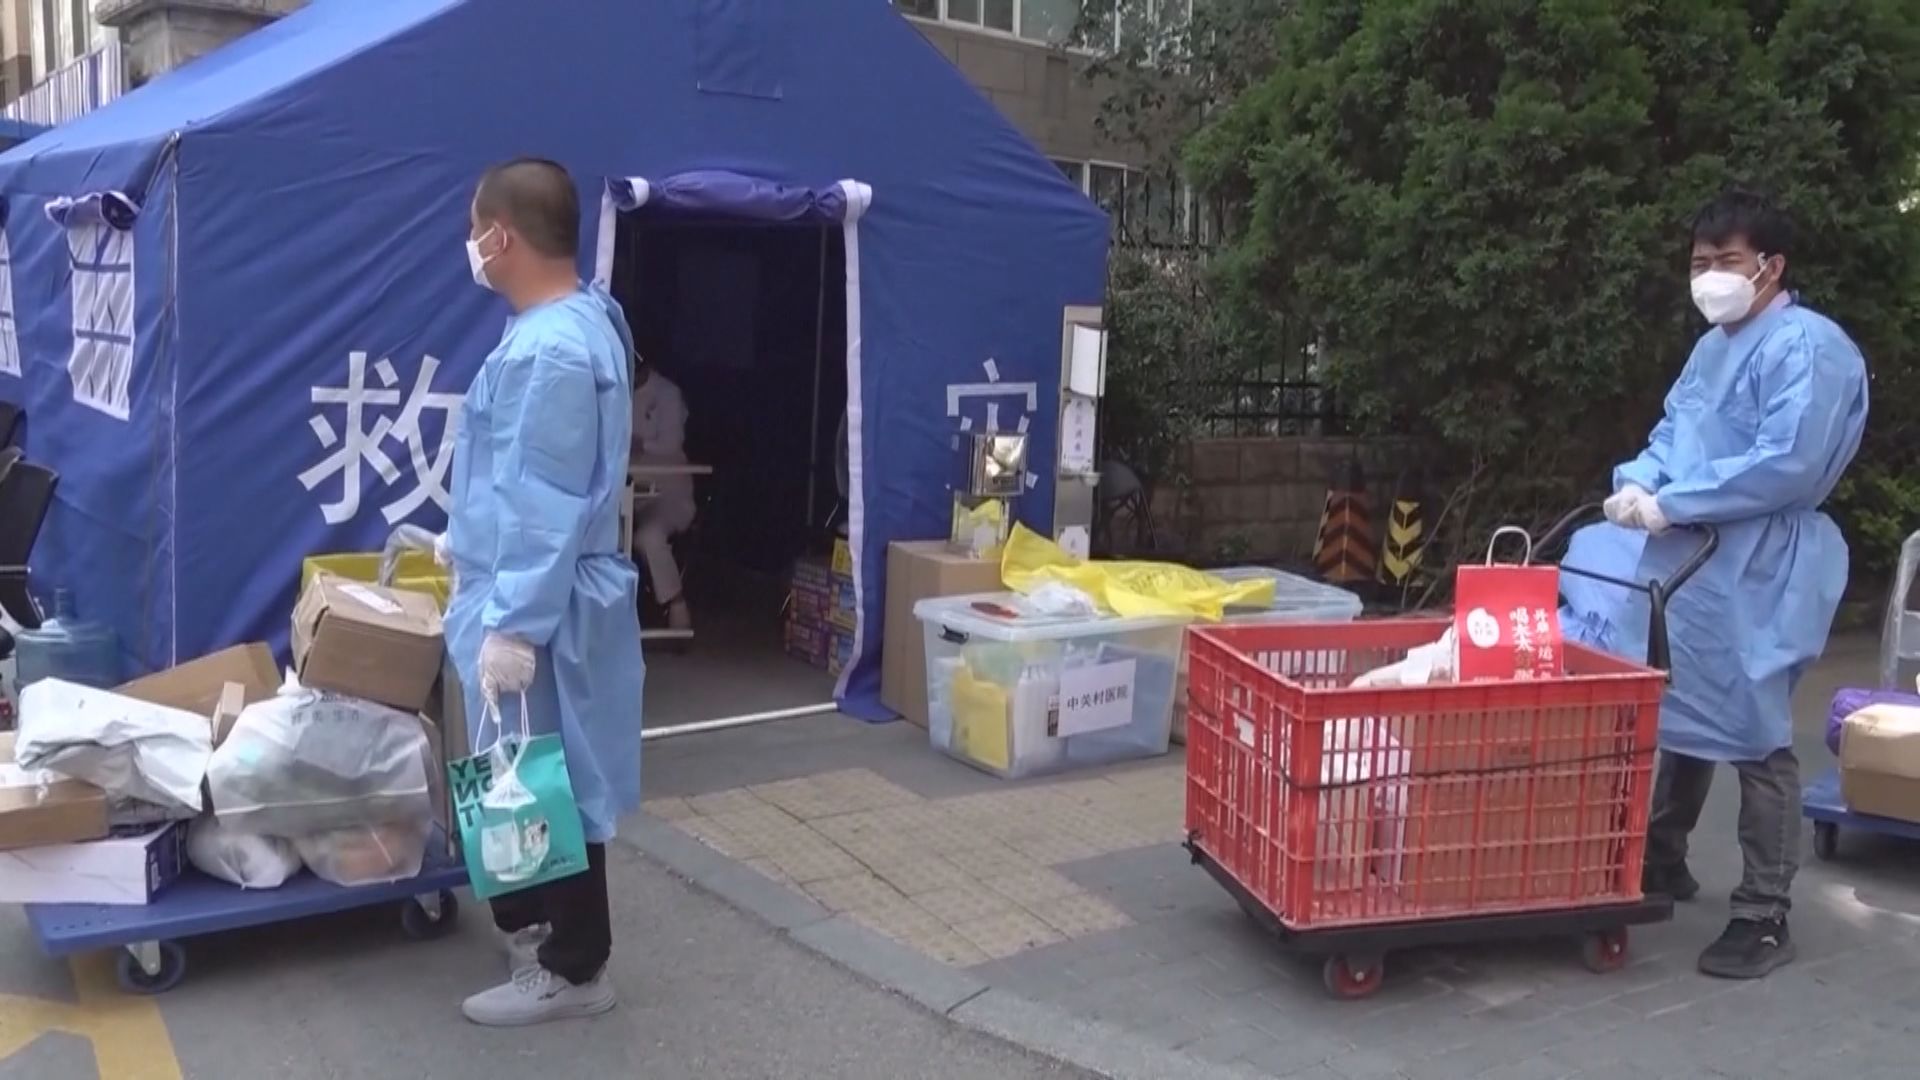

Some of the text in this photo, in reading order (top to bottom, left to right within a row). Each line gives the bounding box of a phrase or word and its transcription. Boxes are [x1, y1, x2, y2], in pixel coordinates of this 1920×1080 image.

[297, 352, 466, 526] 救
[1067, 684, 1128, 712] 中关村医院
